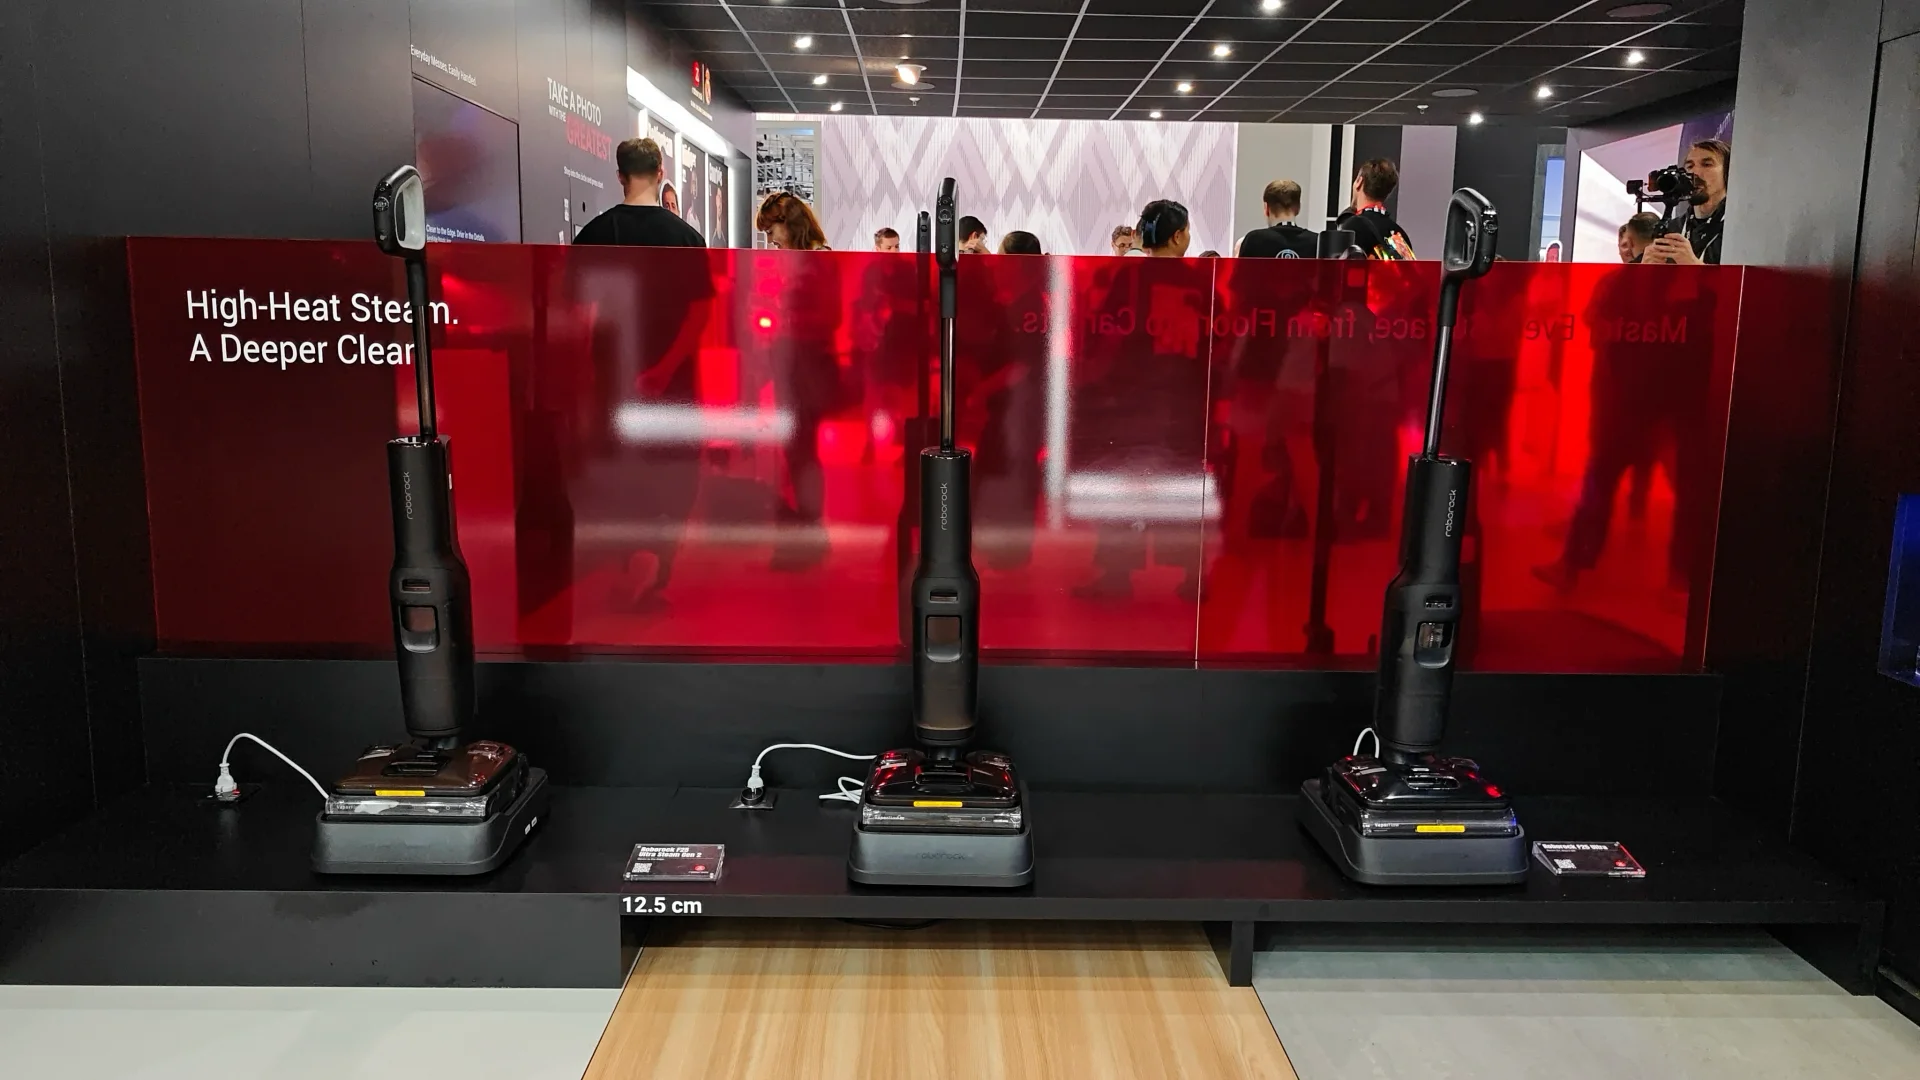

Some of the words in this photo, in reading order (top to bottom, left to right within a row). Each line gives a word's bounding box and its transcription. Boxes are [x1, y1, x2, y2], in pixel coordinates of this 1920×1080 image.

[547, 77, 568, 109] TAKE
[569, 91, 576, 112] A
[576, 94, 602, 127] PHOTO
[548, 104, 558, 119] WITH
[558, 109, 567, 123] THE
[566, 112, 612, 163] GREATEST
[186, 289, 341, 327] High-Heat
[189, 333, 212, 362] A
[220, 334, 328, 371] Deeper
[402, 471, 414, 520] roborock
[940, 482, 948, 531] roborock
[1445, 489, 1457, 538] roborock
[622, 896, 666, 913] 12.5
[671, 899, 703, 914] cm
